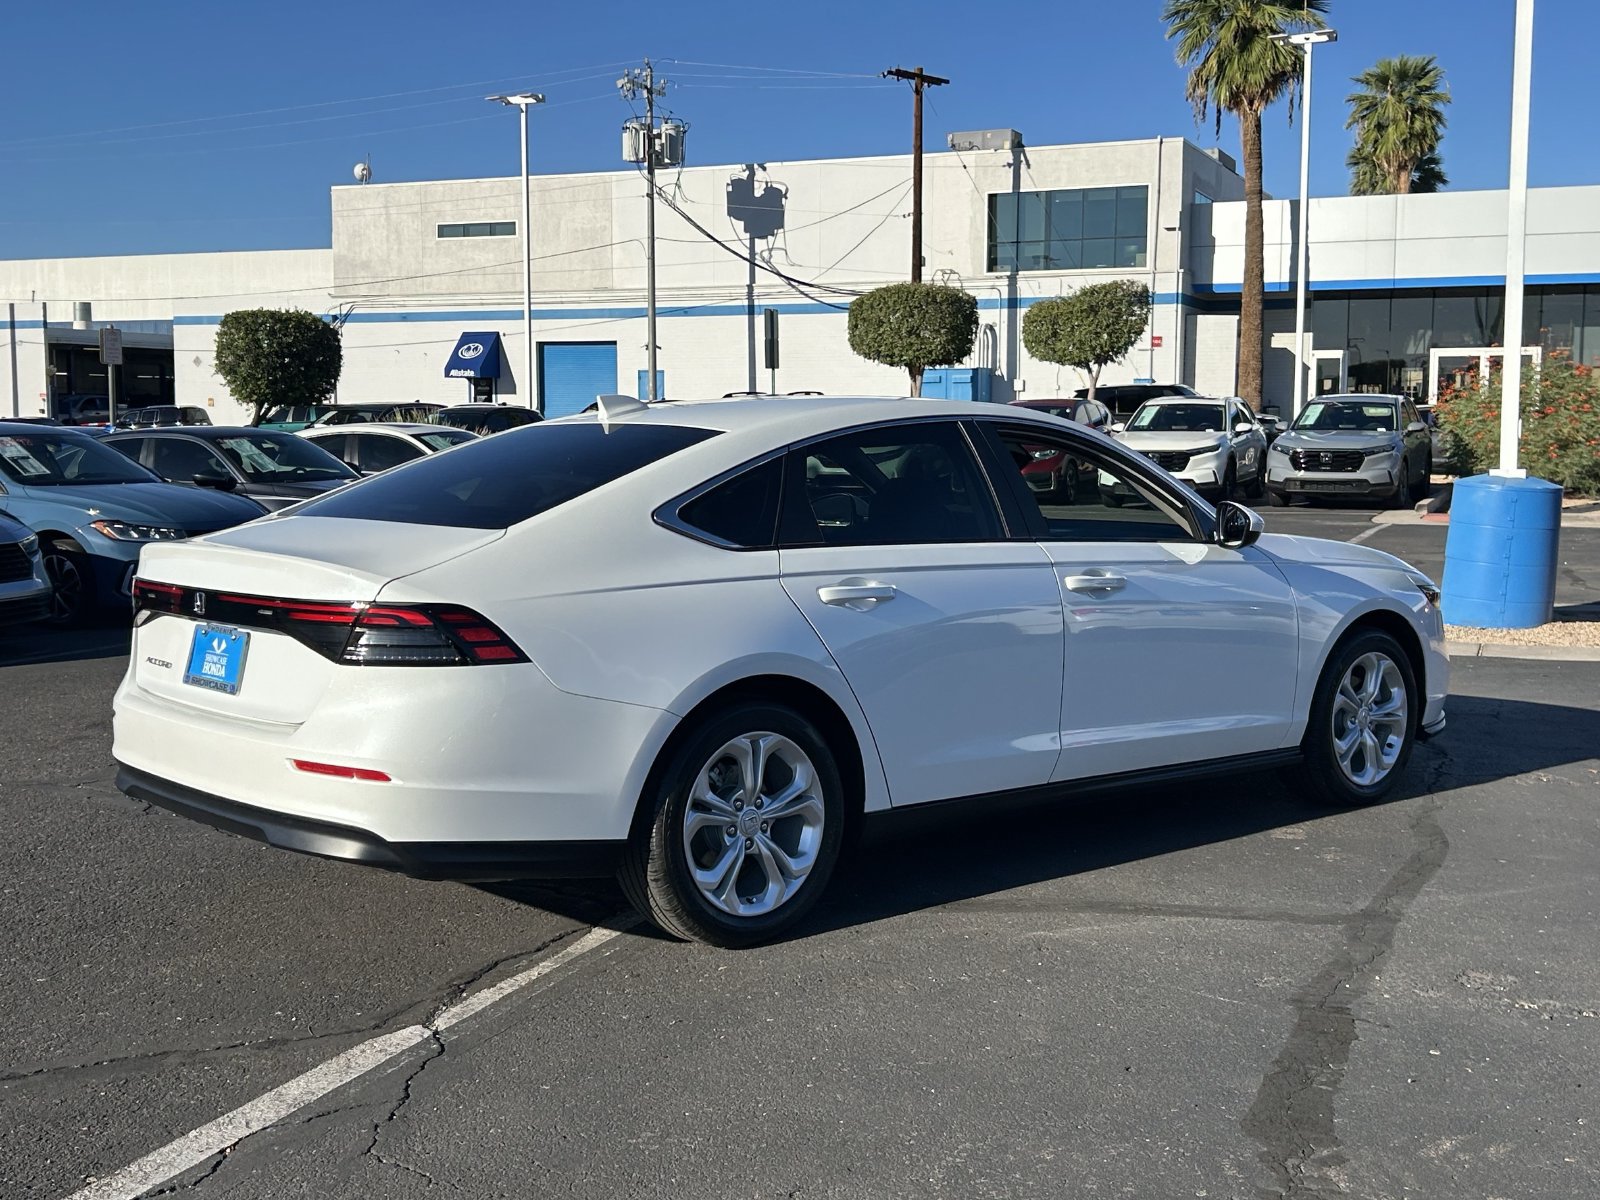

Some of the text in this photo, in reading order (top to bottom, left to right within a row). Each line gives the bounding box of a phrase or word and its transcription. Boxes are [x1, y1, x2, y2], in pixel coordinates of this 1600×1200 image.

[449, 369, 475, 377] Allstate
[146, 656, 173, 669] ACCORD
[202, 661, 226, 678] HONDA
[191, 676, 229, 692] SHOWCASE
